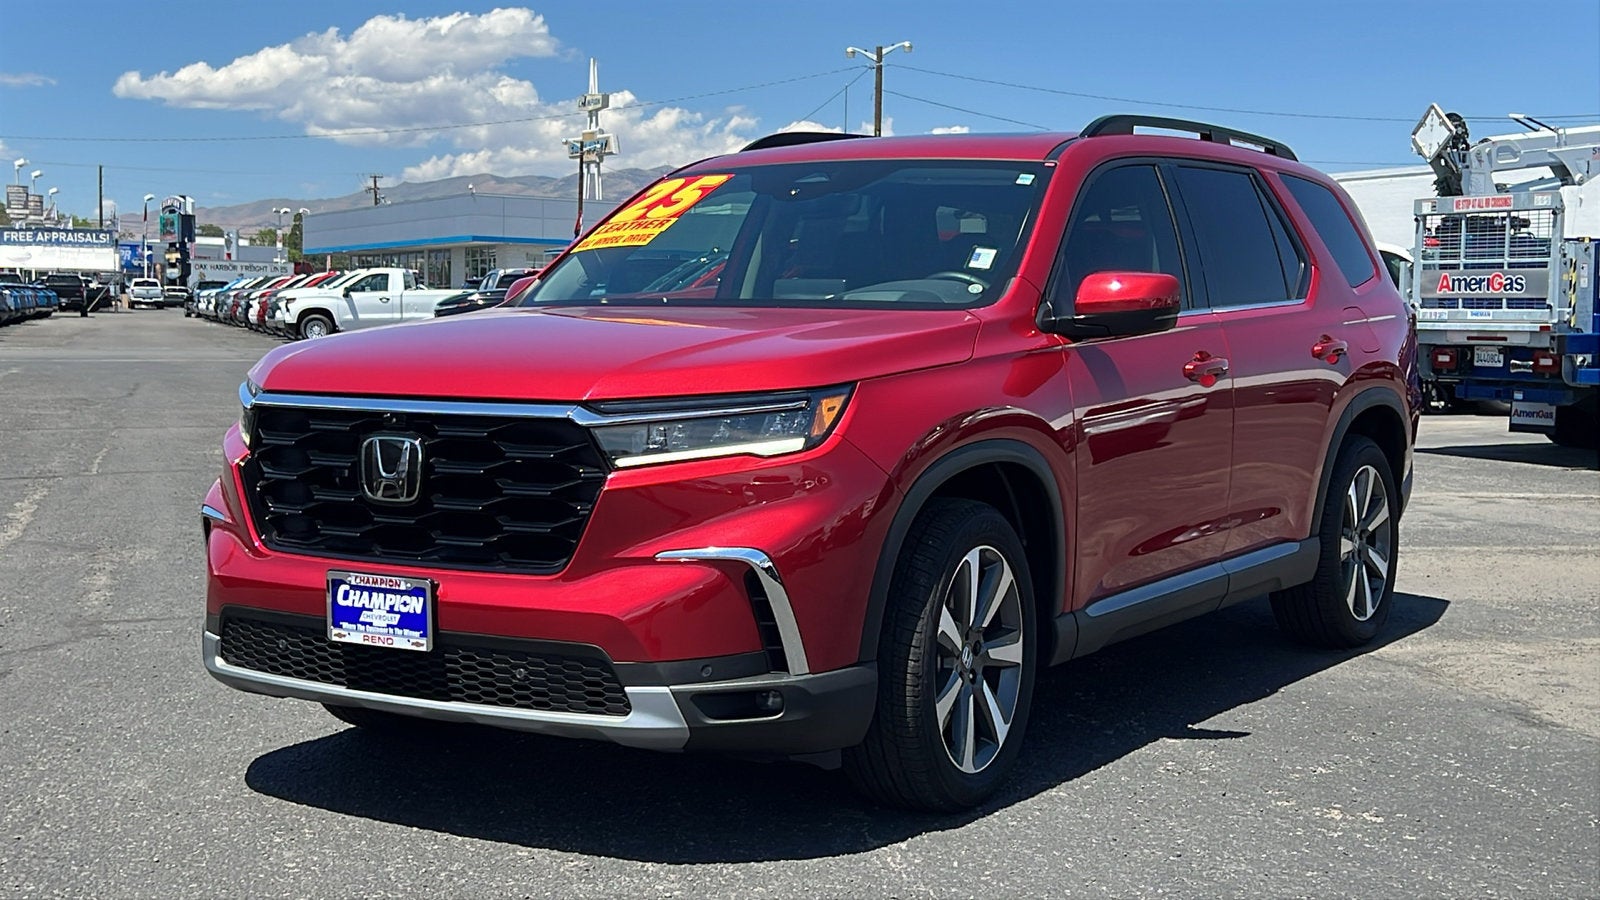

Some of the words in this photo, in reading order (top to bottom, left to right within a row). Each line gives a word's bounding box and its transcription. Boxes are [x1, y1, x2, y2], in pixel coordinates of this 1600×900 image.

[609, 175, 728, 222] 25
[594, 219, 671, 235] LEATHER
[3, 231, 34, 241] FREE
[36, 232, 110, 243] APPRAISALS!
[210, 263, 238, 272] HARBOR
[240, 264, 268, 273] FREIGHT
[270, 265, 288, 273] LINES
[1437, 273, 1525, 293] AmeriGas
[1512, 408, 1554, 420] AmeriGas
[354, 575, 402, 589] CHAMPION
[362, 613, 397, 623] CHEVROLET
[362, 634, 394, 646] RENO
